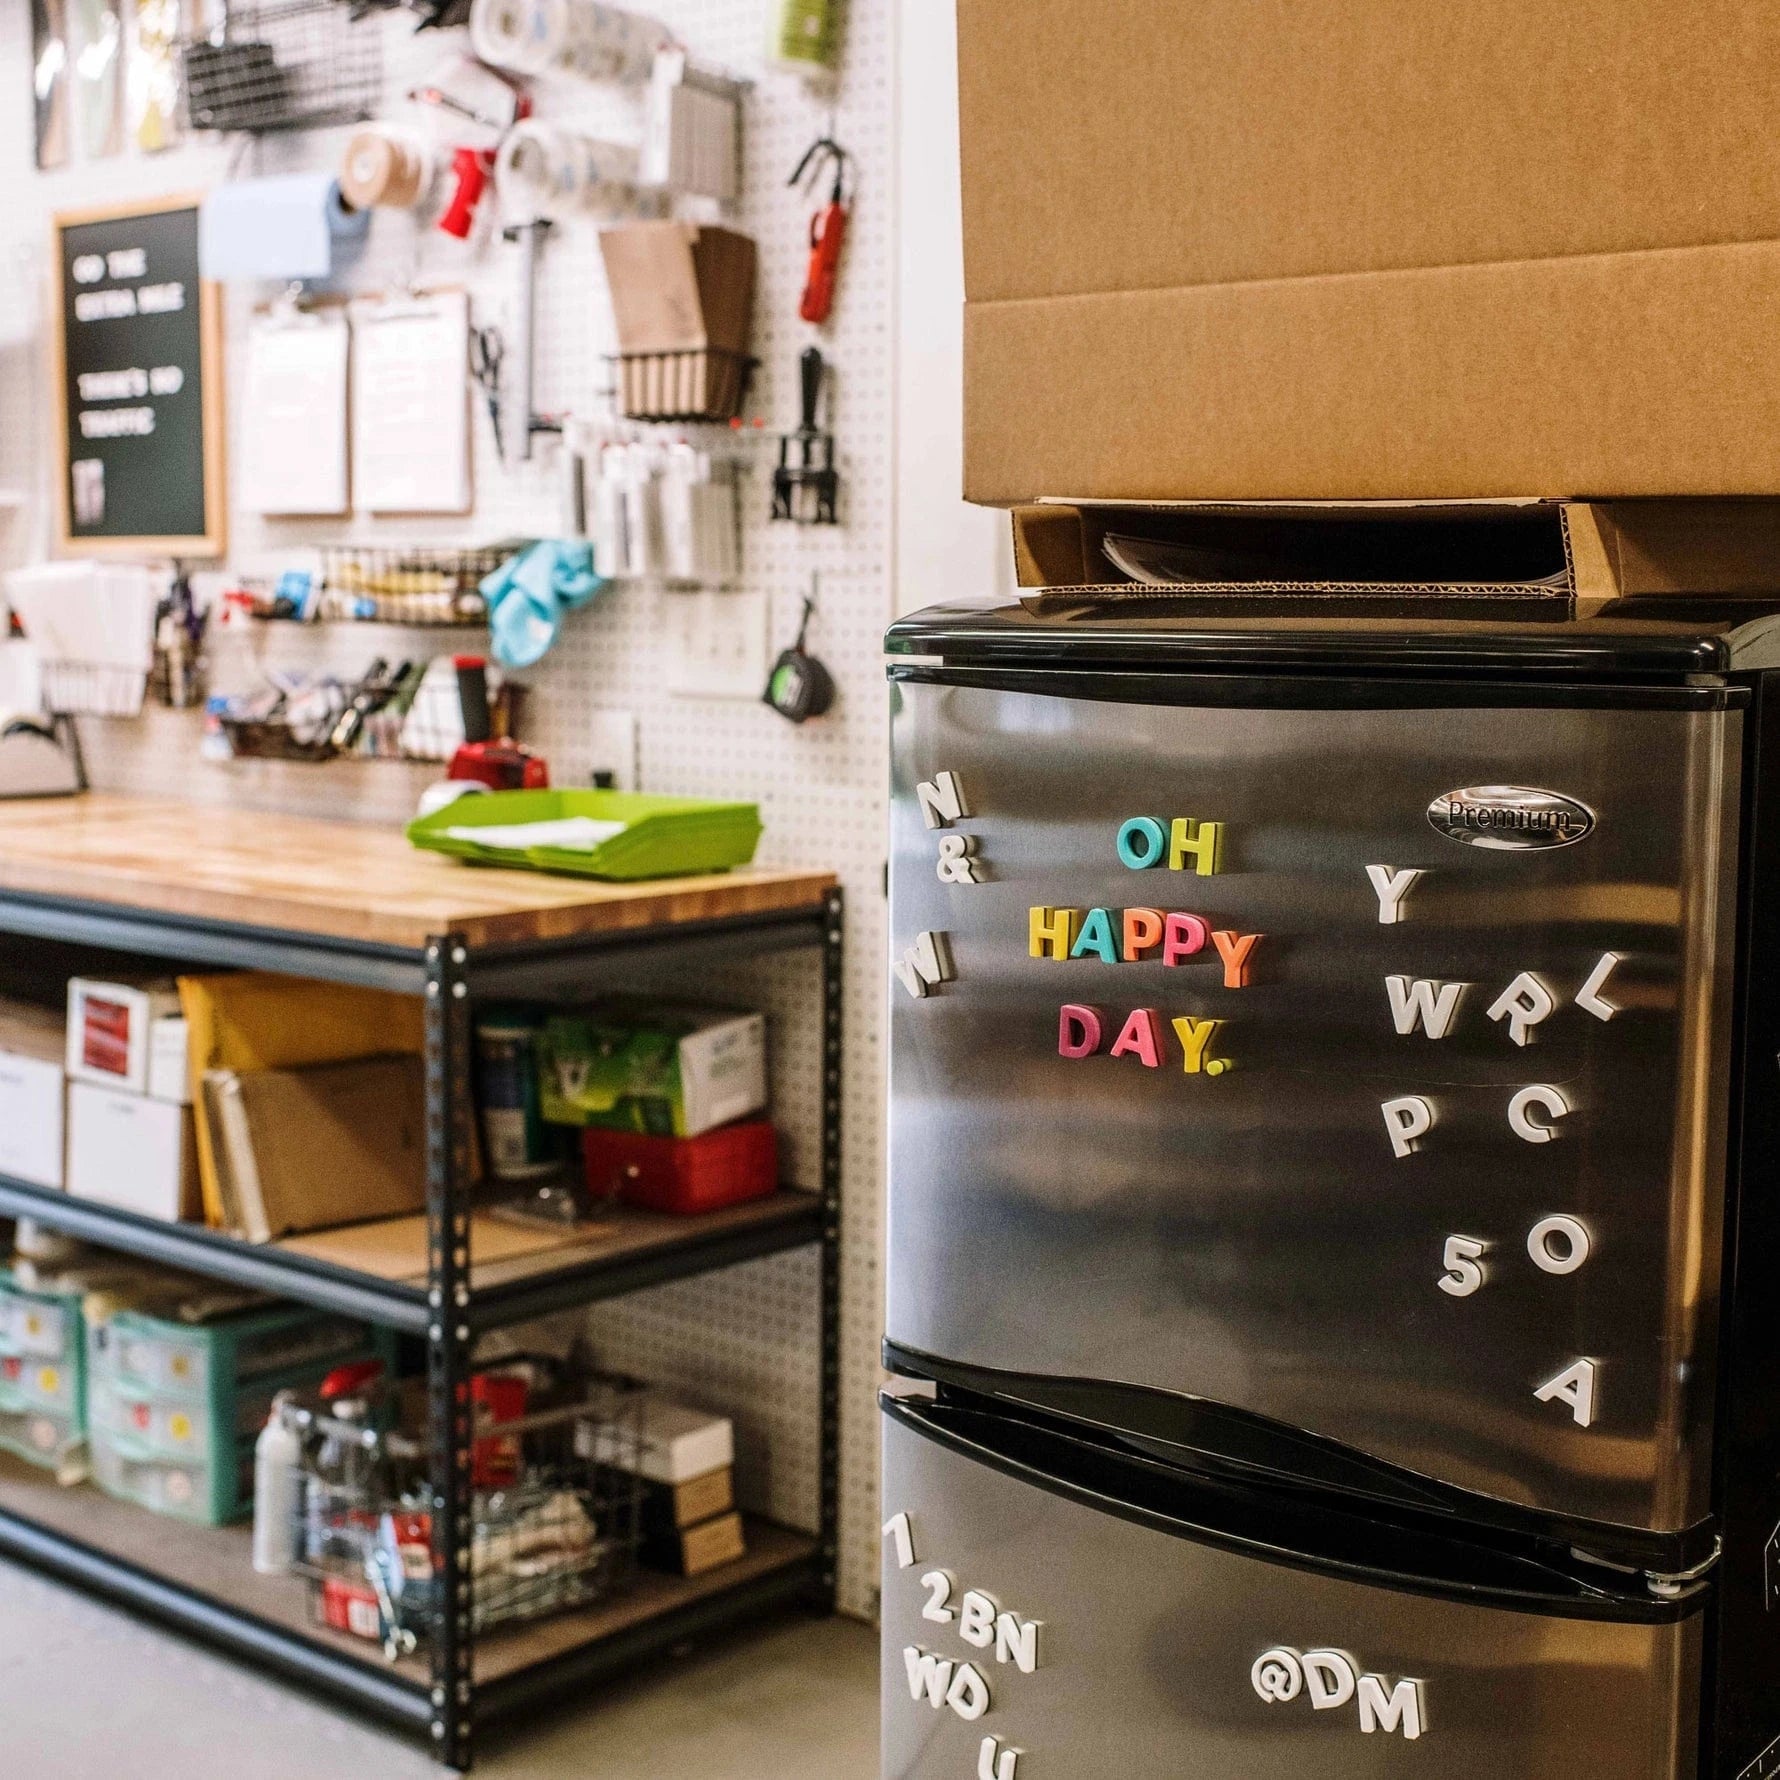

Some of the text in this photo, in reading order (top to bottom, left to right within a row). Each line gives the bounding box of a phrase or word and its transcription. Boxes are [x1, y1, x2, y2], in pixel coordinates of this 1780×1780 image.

[917, 771, 965, 830] N
[1448, 801, 1571, 831] Premium
[936, 835, 977, 884] &
[1116, 816, 1220, 876] OH
[1366, 865, 1420, 924] Y
[1029, 906, 1262, 989] HAPPY
[1385, 952, 1620, 1047] W R L
[1058, 1003, 1228, 1077] DAY.
[1381, 1085, 1568, 1158] P C
[1437, 1235, 1485, 1297] 5
[1533, 1359, 1596, 1428] A
